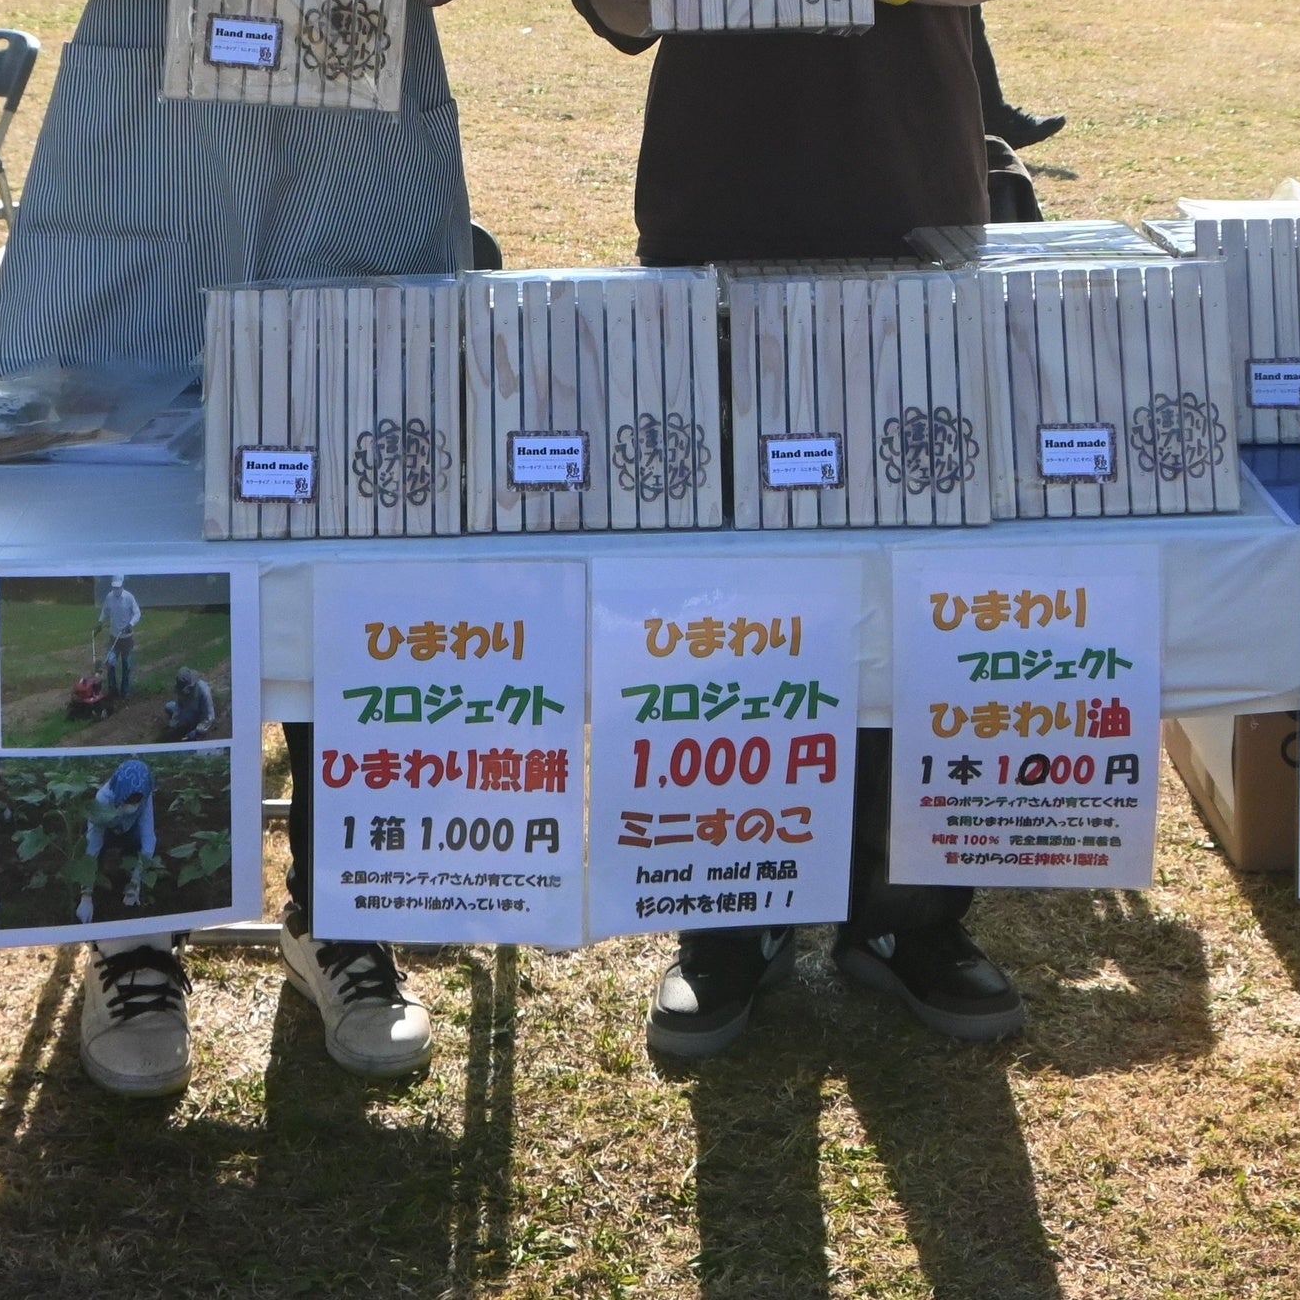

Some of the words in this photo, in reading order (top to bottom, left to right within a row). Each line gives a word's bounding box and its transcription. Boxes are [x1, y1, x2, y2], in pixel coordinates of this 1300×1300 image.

[215, 28, 243, 38] Hand
[246, 32, 273, 41] made
[1254, 372, 1281, 380] Hand
[517, 447, 547, 455] Hand
[550, 447, 580, 455] made
[771, 450, 801, 458] Hand
[804, 449, 833, 457] made
[1045, 440, 1074, 448] Hand
[1076, 439, 1106, 447] made
[246, 461, 276, 470] Hand
[279, 462, 309, 470] made
[930, 588, 1086, 631] ひまわり
[365, 620, 525, 661] ひまわり
[644, 616, 802, 657] ひまわり
[958, 648, 1133, 682] プロジェクト
[343, 684, 565, 726] プロジェクト
[621, 680, 839, 723] プロジェクト
[930, 697, 1132, 739] ひまわり油
[322, 748, 568, 793] ひまわり煎餅
[633, 736, 771, 788] 1,000
[785, 733, 836, 785] 円
[948, 755, 983, 785] 本
[1104, 754, 1140, 785] 円
[919, 796, 1138, 809] 全国のボランティアさんが育ててくれた
[421, 817, 514, 853] 1,000
[525, 818, 559, 854] 円
[617, 806, 814, 849] ミニすのこ
[946, 815, 1120, 828] 食用ひまわり油が入っています。
[340, 870, 562, 888] 全国のボランティアさんが育ててくれた
[636, 863, 693, 884] hand
[707, 861, 751, 881] maid
[756, 860, 798, 881] 商品
[355, 895, 531, 913] 食用ひまわり油が入っています。
